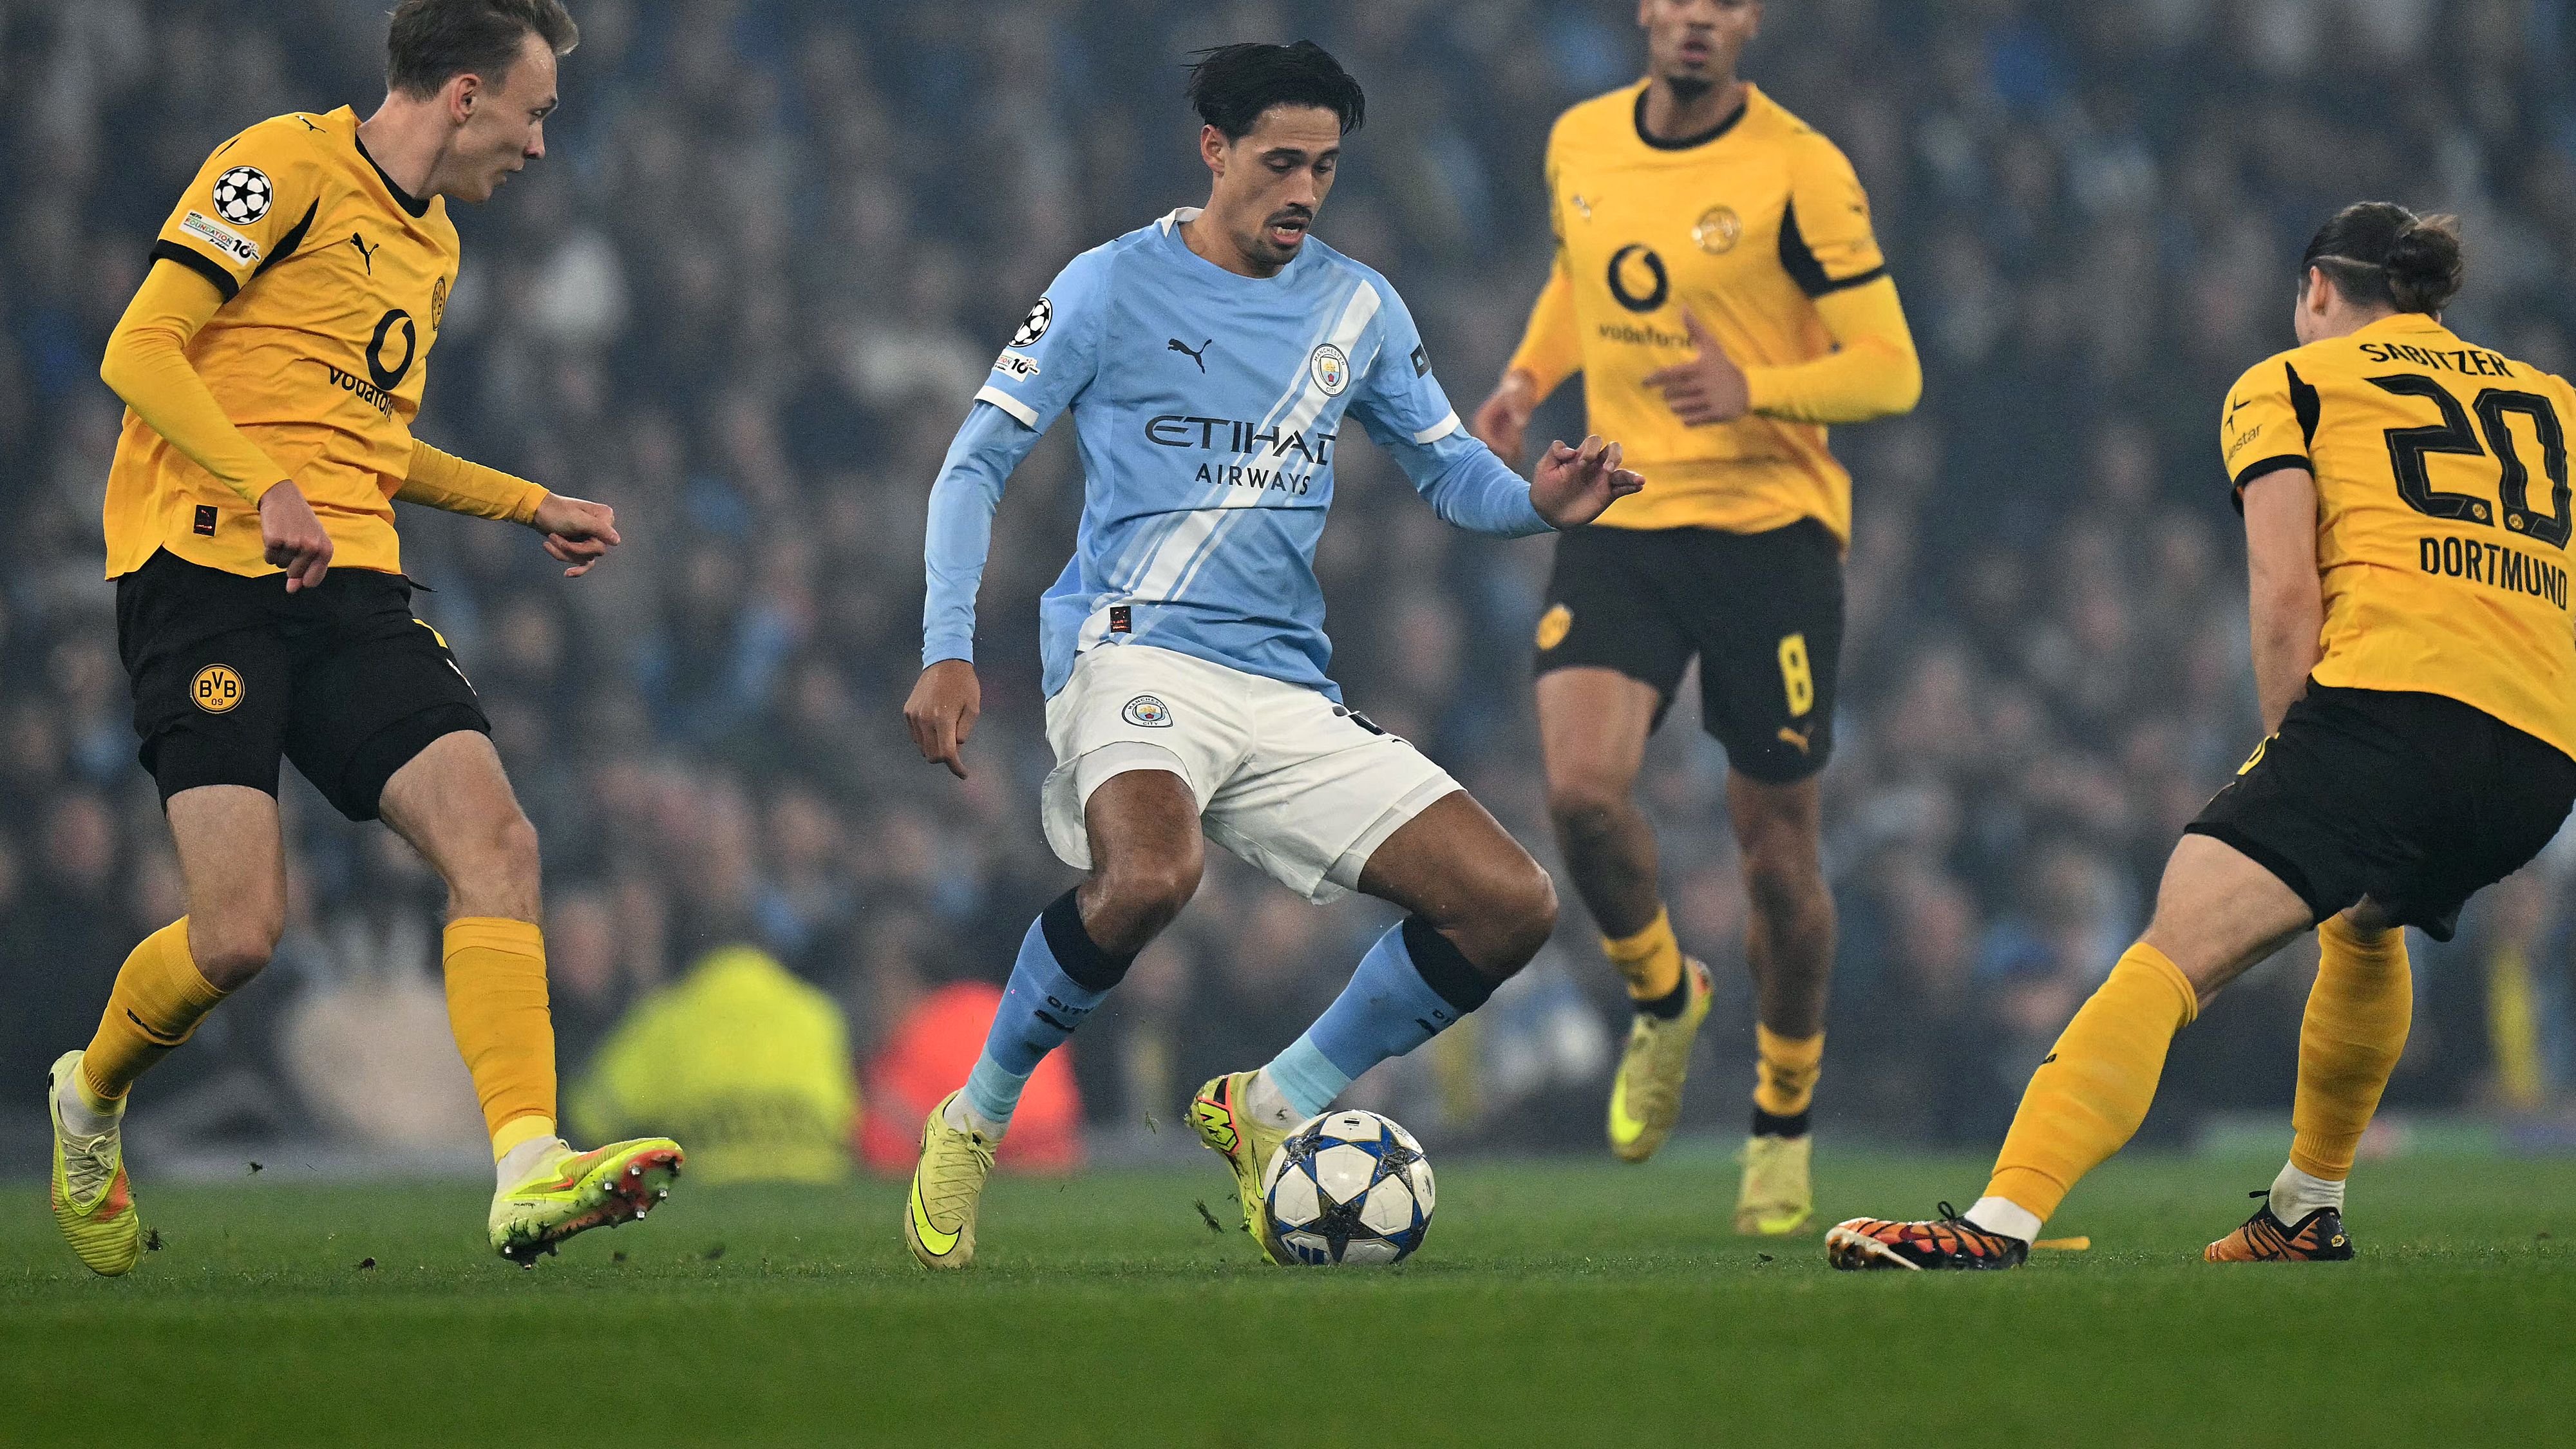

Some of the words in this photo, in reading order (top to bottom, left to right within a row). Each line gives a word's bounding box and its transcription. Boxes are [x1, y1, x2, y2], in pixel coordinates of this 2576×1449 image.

[185, 218, 232, 245] FOUNDATION
[232, 239, 251, 258] 10
[1011, 358, 1029, 374] 10
[1314, 348, 1345, 366] MANCHESTER
[2359, 343, 2515, 378] SABITZER
[2226, 423, 2263, 462] estar
[2363, 374, 2573, 551] 20
[1195, 462, 1311, 496] AIRWAYS
[2420, 536, 2568, 611] DORTMUND
[200, 671, 237, 698] BVB
[1777, 632, 1814, 717] 8
[1127, 697, 1168, 714] MANCHESTER
